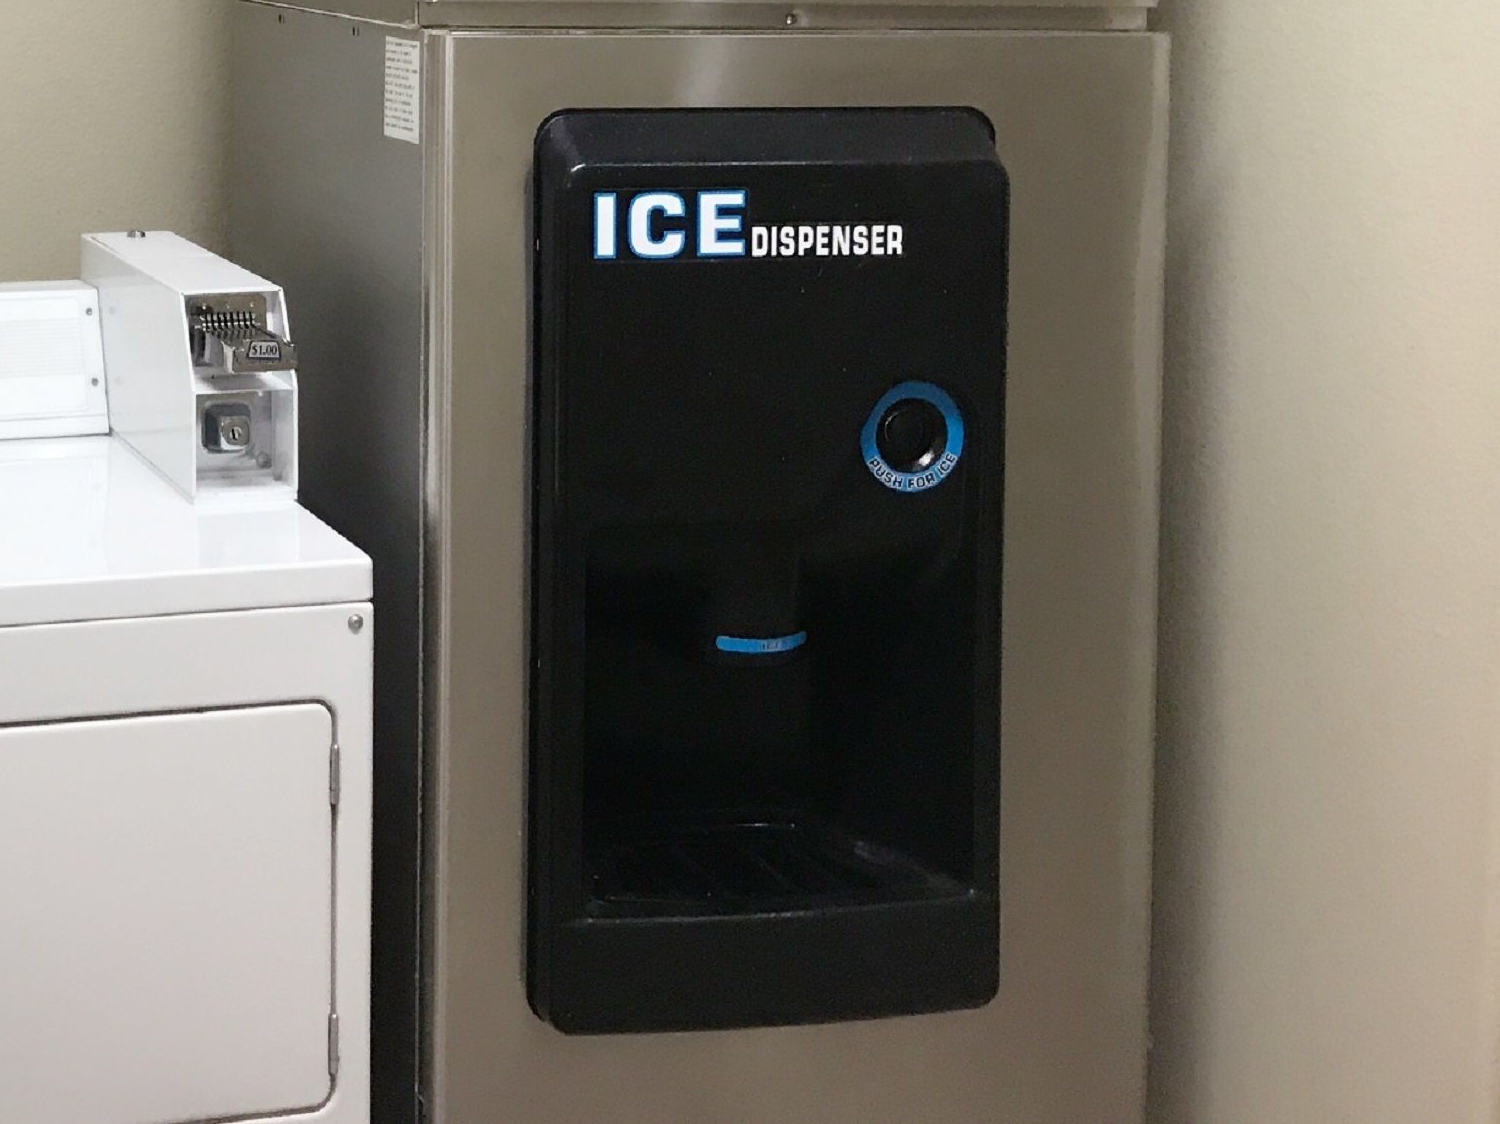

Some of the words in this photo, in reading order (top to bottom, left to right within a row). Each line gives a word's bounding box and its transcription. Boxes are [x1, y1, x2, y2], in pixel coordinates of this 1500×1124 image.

[593, 188, 748, 260] ICE
[750, 223, 903, 258] DISPENSER
[251, 343, 278, 356] $1.00
[869, 457, 903, 489] PUSH
[907, 472, 936, 489] FOR
[937, 452, 957, 477] ICE
